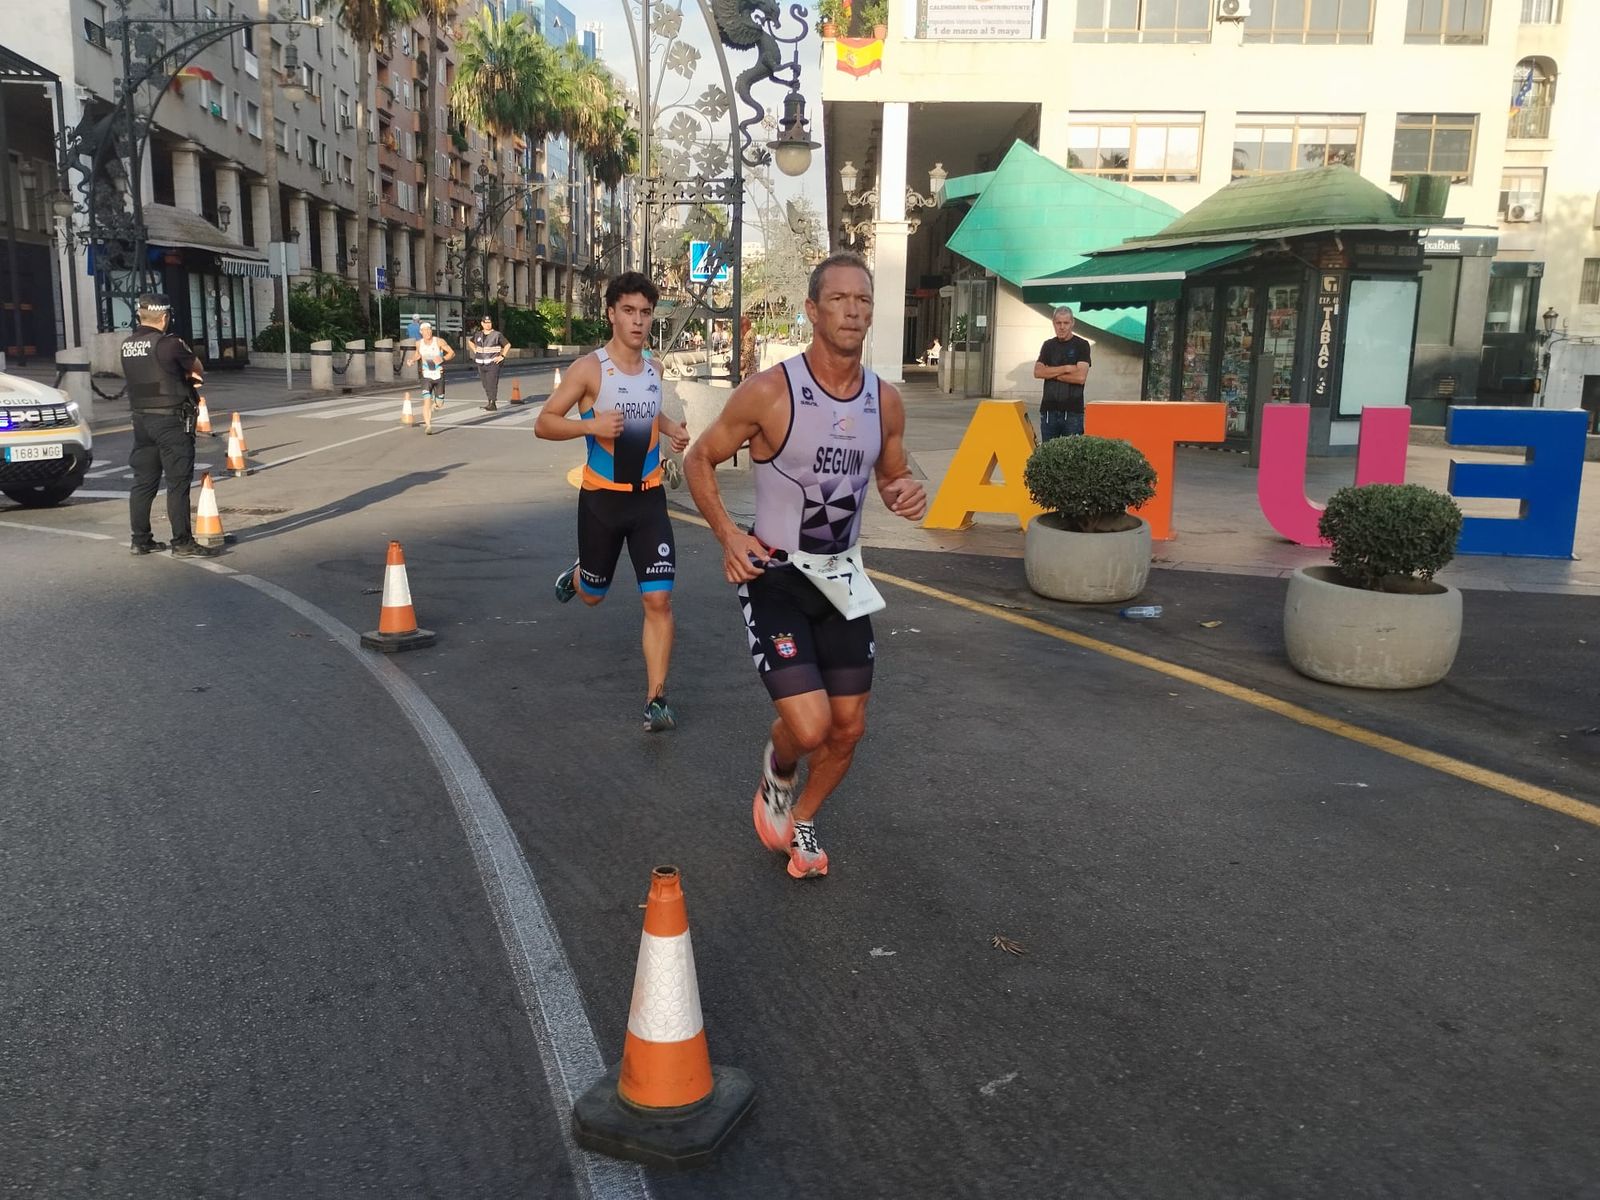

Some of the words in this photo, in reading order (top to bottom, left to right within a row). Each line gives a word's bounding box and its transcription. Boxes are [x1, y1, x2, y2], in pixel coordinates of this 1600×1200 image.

[941, 27, 951, 35] de
[980, 27, 988, 35] al
[991, 27, 996, 35] 5
[997, 28, 1020, 36] mayo
[1424, 240, 1461, 250] ixaBank
[121, 340, 151, 350] POLICIA
[123, 348, 148, 357] LOCAL
[1316, 306, 1333, 395] TABACS
[15, 447, 39, 459] 1683
[813, 446, 864, 476] SEGUIN
